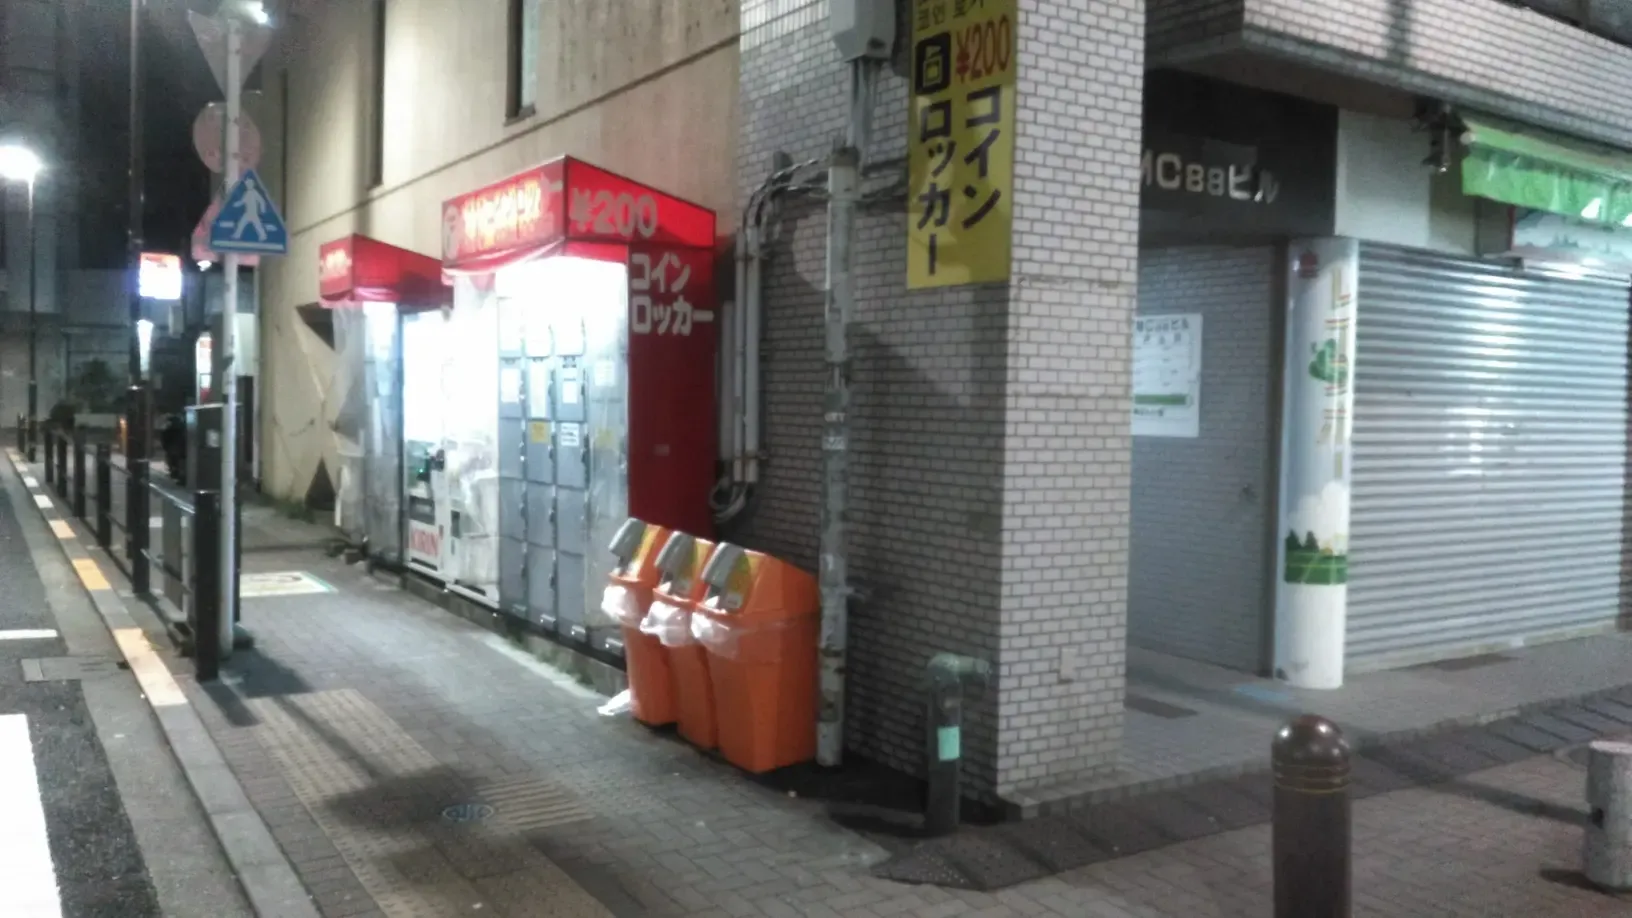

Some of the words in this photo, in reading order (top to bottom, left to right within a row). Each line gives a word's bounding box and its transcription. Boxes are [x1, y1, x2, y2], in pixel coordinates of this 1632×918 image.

[956, 13, 1011, 84] ¥200
[918, 98, 957, 276] ロッカー
[963, 85, 1002, 230] コイン
[569, 187, 657, 238] ¥200
[630, 252, 691, 293] コイン
[630, 296, 715, 336] ロッカー
